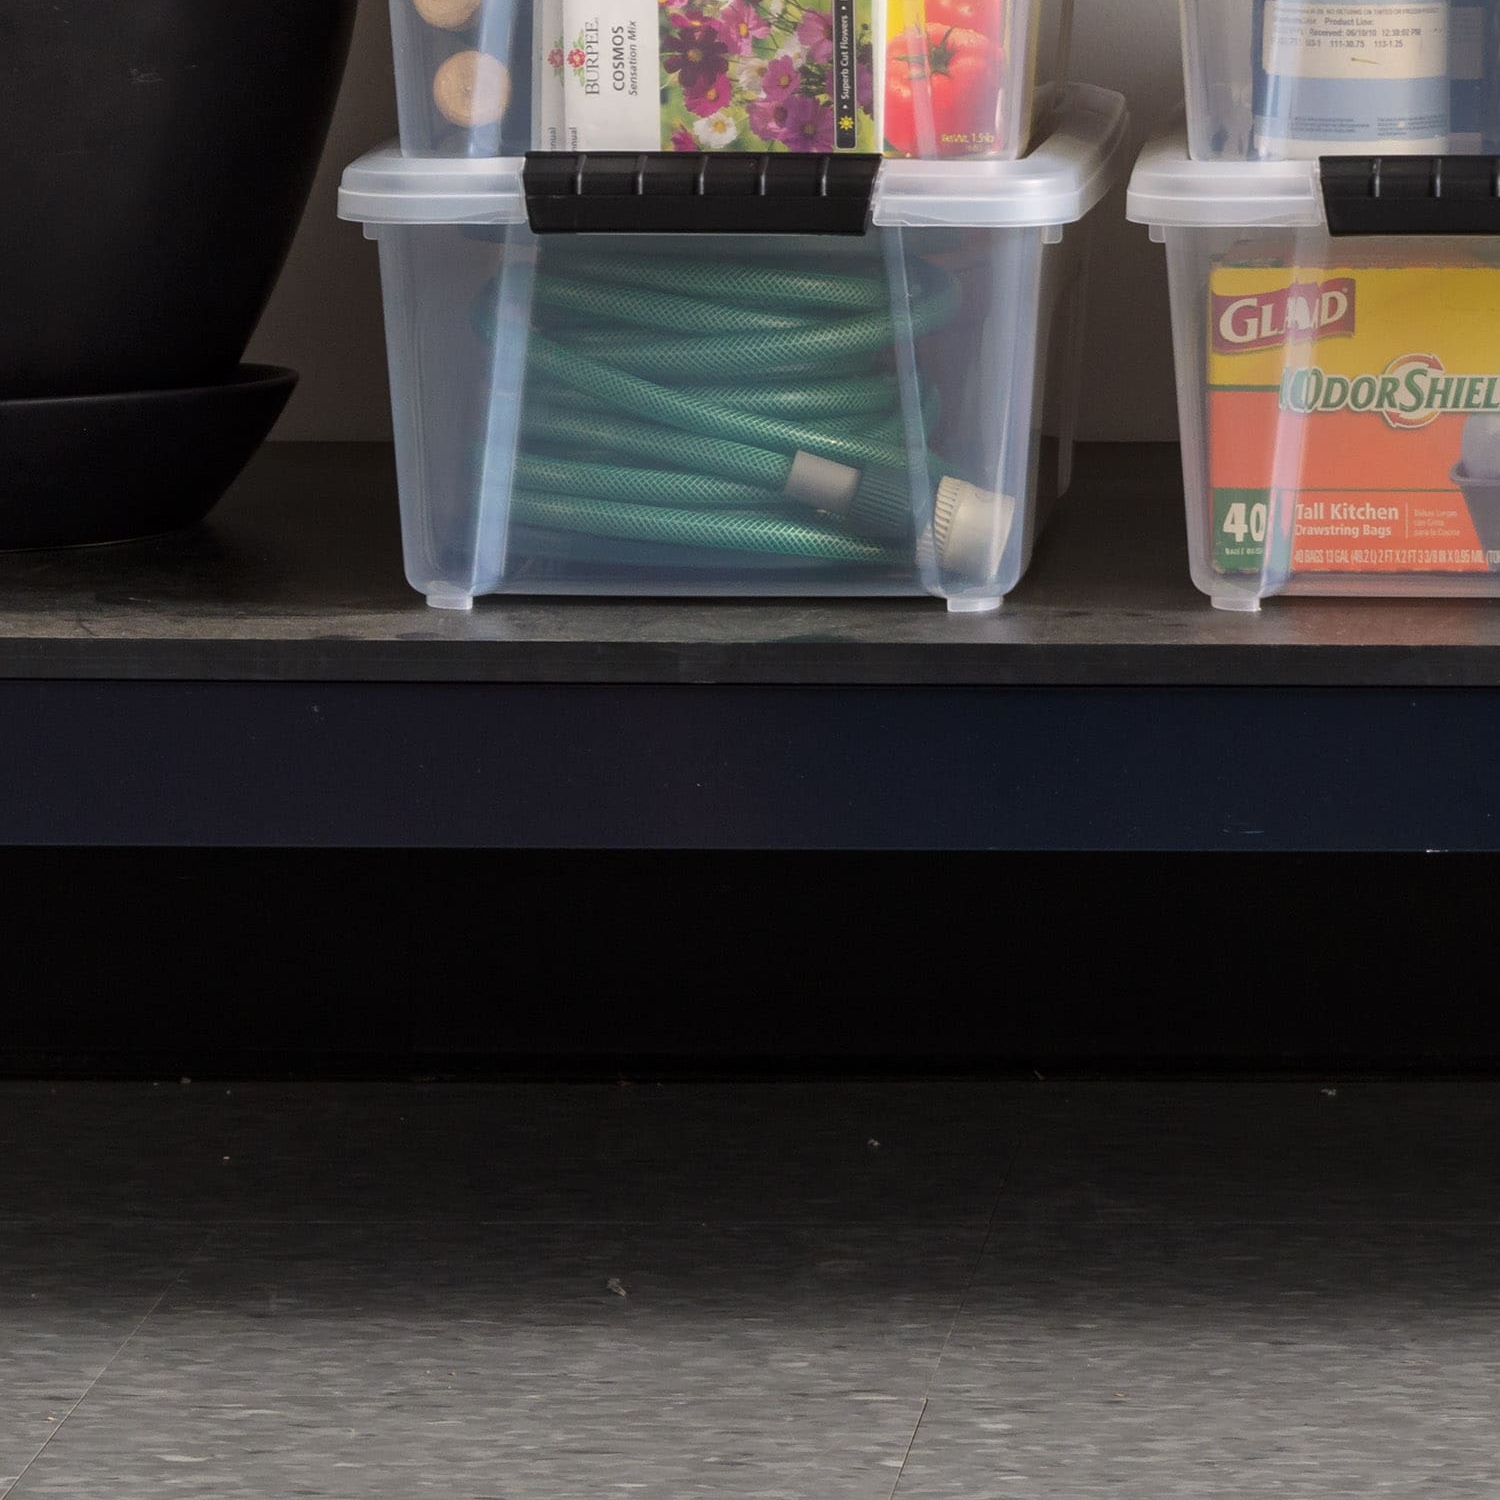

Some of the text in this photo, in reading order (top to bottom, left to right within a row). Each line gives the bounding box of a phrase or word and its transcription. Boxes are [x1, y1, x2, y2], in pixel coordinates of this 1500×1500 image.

[840, 15, 849, 50] Flowers
[1324, 17, 1354, 26] Product
[585, 21, 600, 95] BURPEE
[612, 26, 625, 91] COSMOS
[628, 20, 638, 96] Sensation Mix
[840, 51, 849, 66] Cut
[841, 68, 851, 100] Superb
[1223, 503, 1267, 542] 40
[1331, 502, 1399, 520] Kitchen
[1362, 524, 1392, 539] Bags
